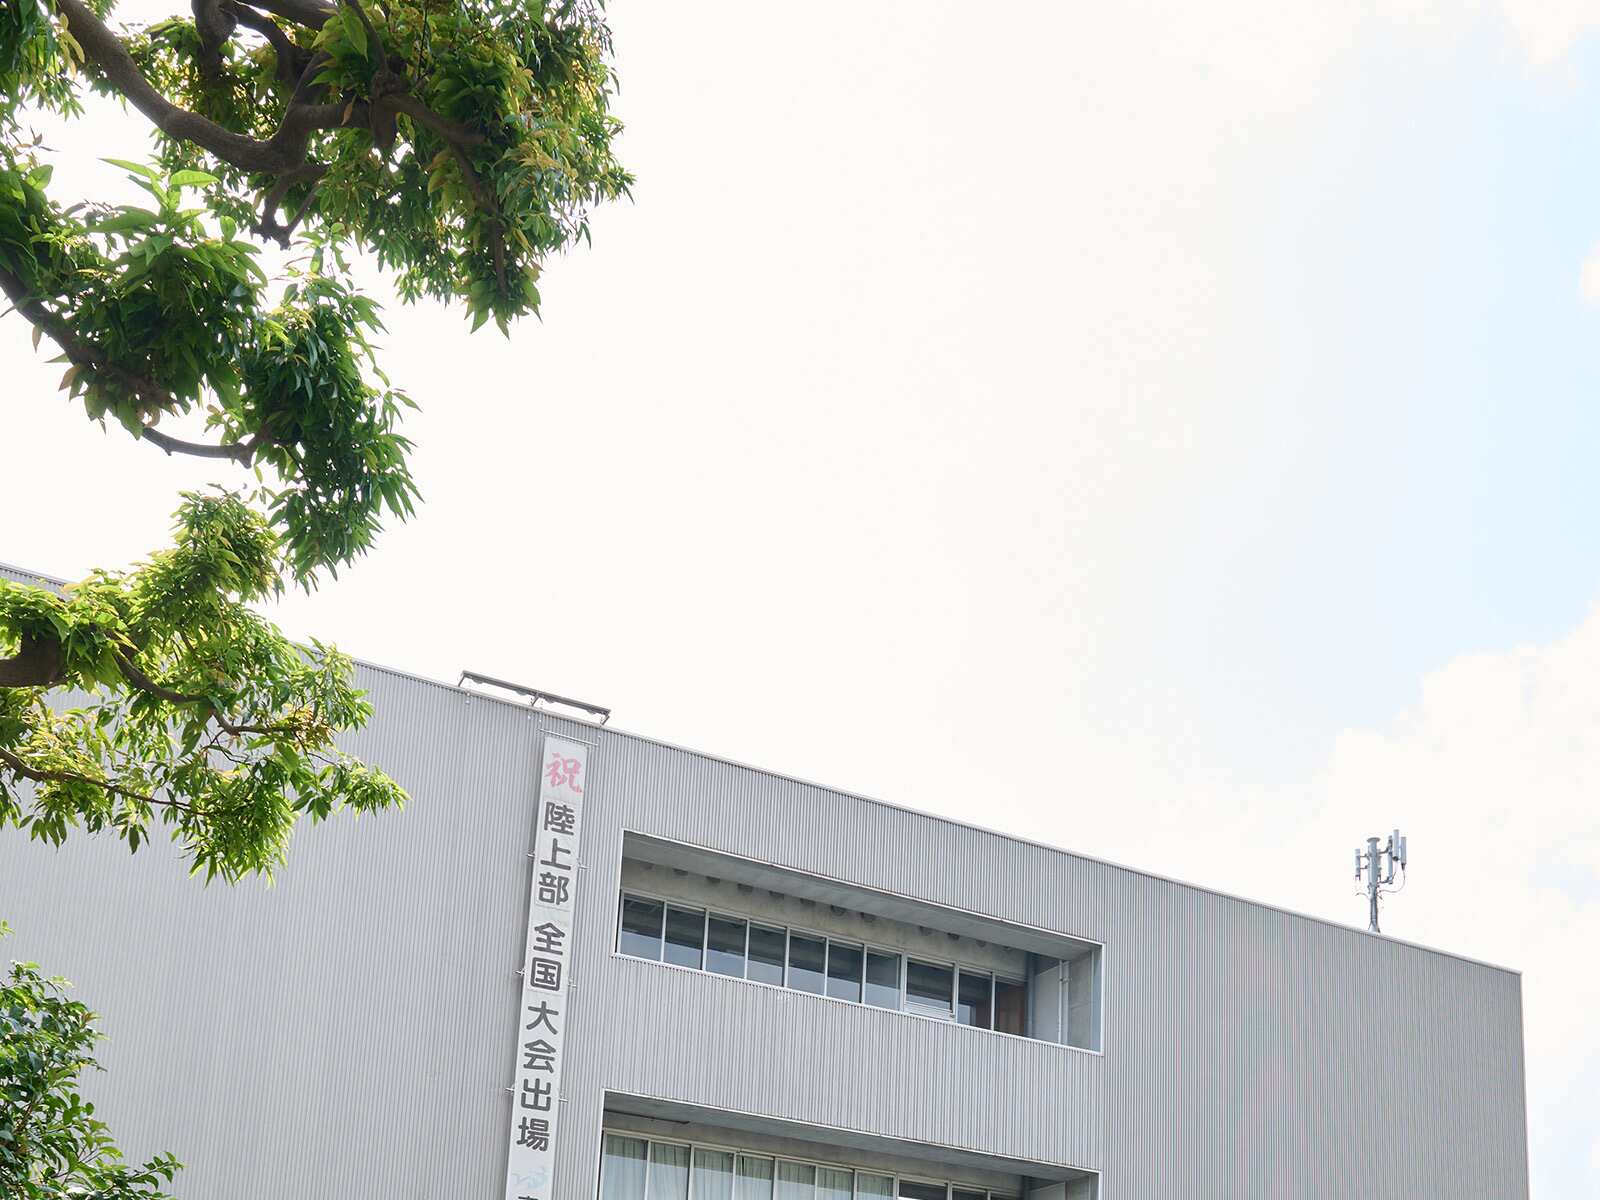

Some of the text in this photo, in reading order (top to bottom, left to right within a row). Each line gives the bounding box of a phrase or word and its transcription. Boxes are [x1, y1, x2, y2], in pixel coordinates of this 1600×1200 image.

[545, 752, 583, 794] 祝
[537, 801, 576, 906] 陸上部
